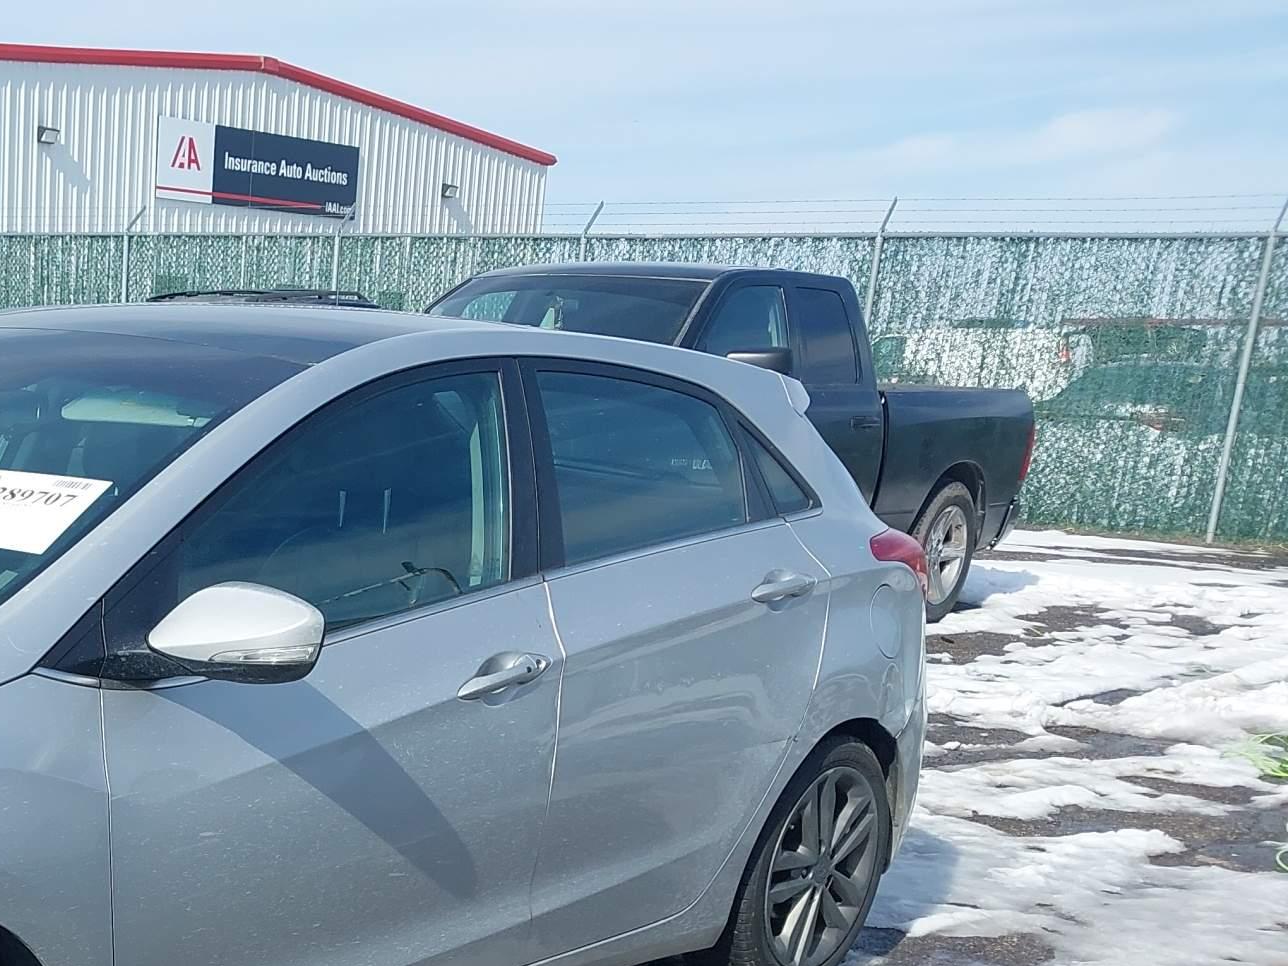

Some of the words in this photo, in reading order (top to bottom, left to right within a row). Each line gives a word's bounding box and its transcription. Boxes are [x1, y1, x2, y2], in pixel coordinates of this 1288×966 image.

[224, 151, 277, 176] Insurance
[278, 159, 303, 179] Auto
[304, 163, 348, 186] Auctions
